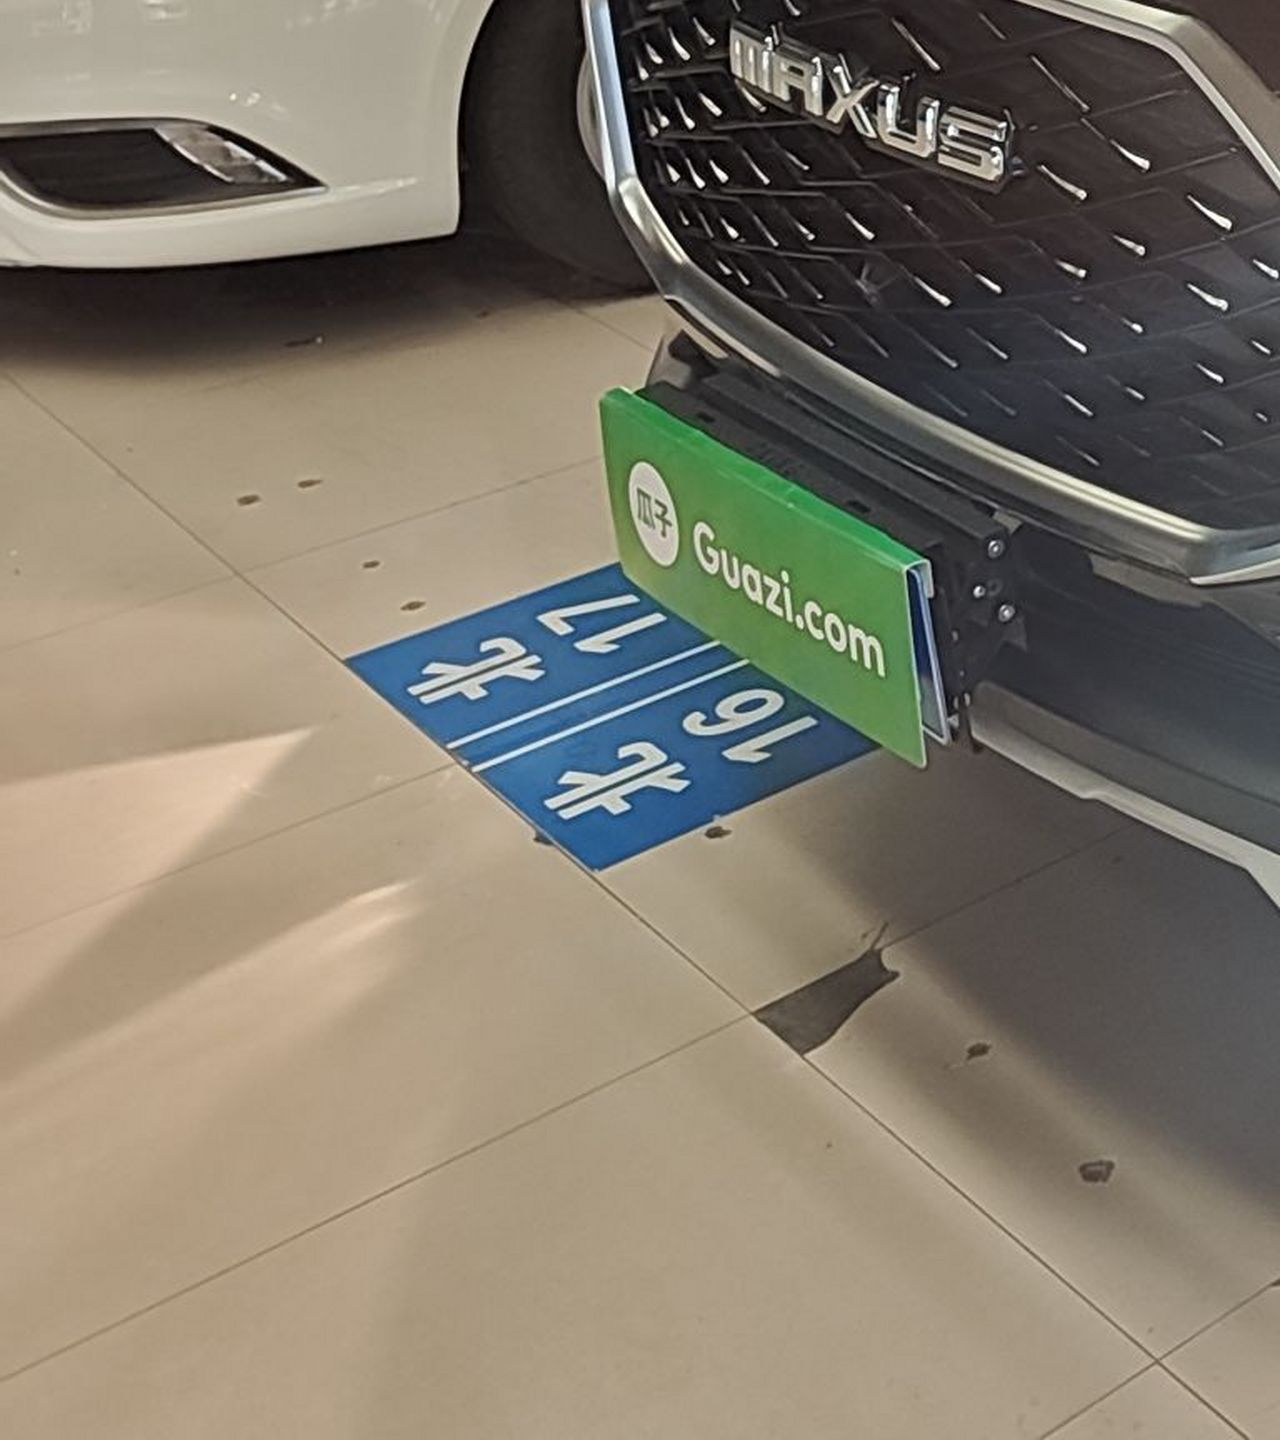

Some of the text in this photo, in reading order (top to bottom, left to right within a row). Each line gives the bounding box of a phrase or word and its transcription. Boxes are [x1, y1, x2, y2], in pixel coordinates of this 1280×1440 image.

[728, 22, 1009, 184] MAXUS
[635, 487, 673, 538] 瓜子
[536, 593, 666, 655] 17
[692, 520, 886, 678] Guazi.com
[407, 636, 546, 706] 北
[682, 687, 819, 765] 16
[542, 741, 691, 821] 北
